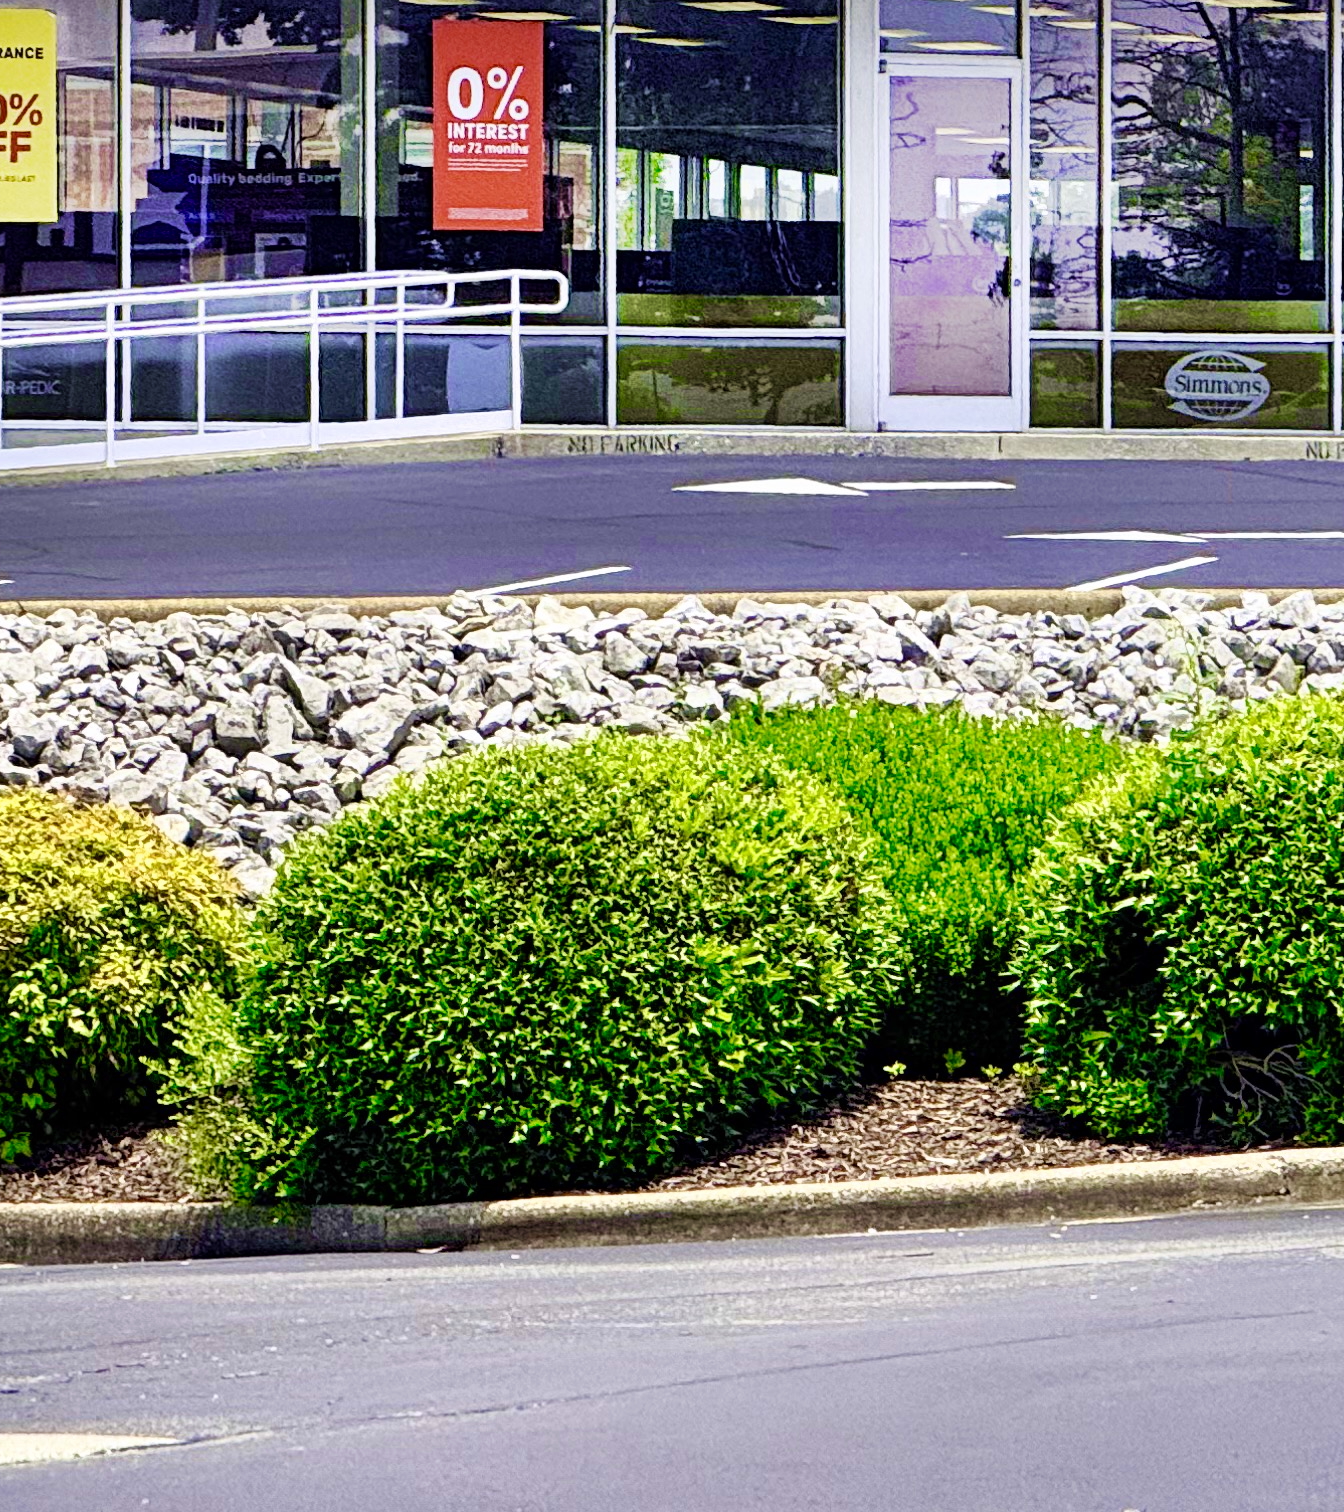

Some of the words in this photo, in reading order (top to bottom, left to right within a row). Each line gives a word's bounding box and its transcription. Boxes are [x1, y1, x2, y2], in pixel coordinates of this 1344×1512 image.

[447, 65, 530, 121] 0%
[447, 122, 530, 141] INTEREST
[448, 141, 467, 154] for
[468, 142, 483, 155] 72
[484, 142, 530, 156] months
[187, 172, 236, 186] Quality
[567, 434, 594, 453] NO
[600, 434, 680, 454] PARKING
[1306, 441, 1331, 460] NO
